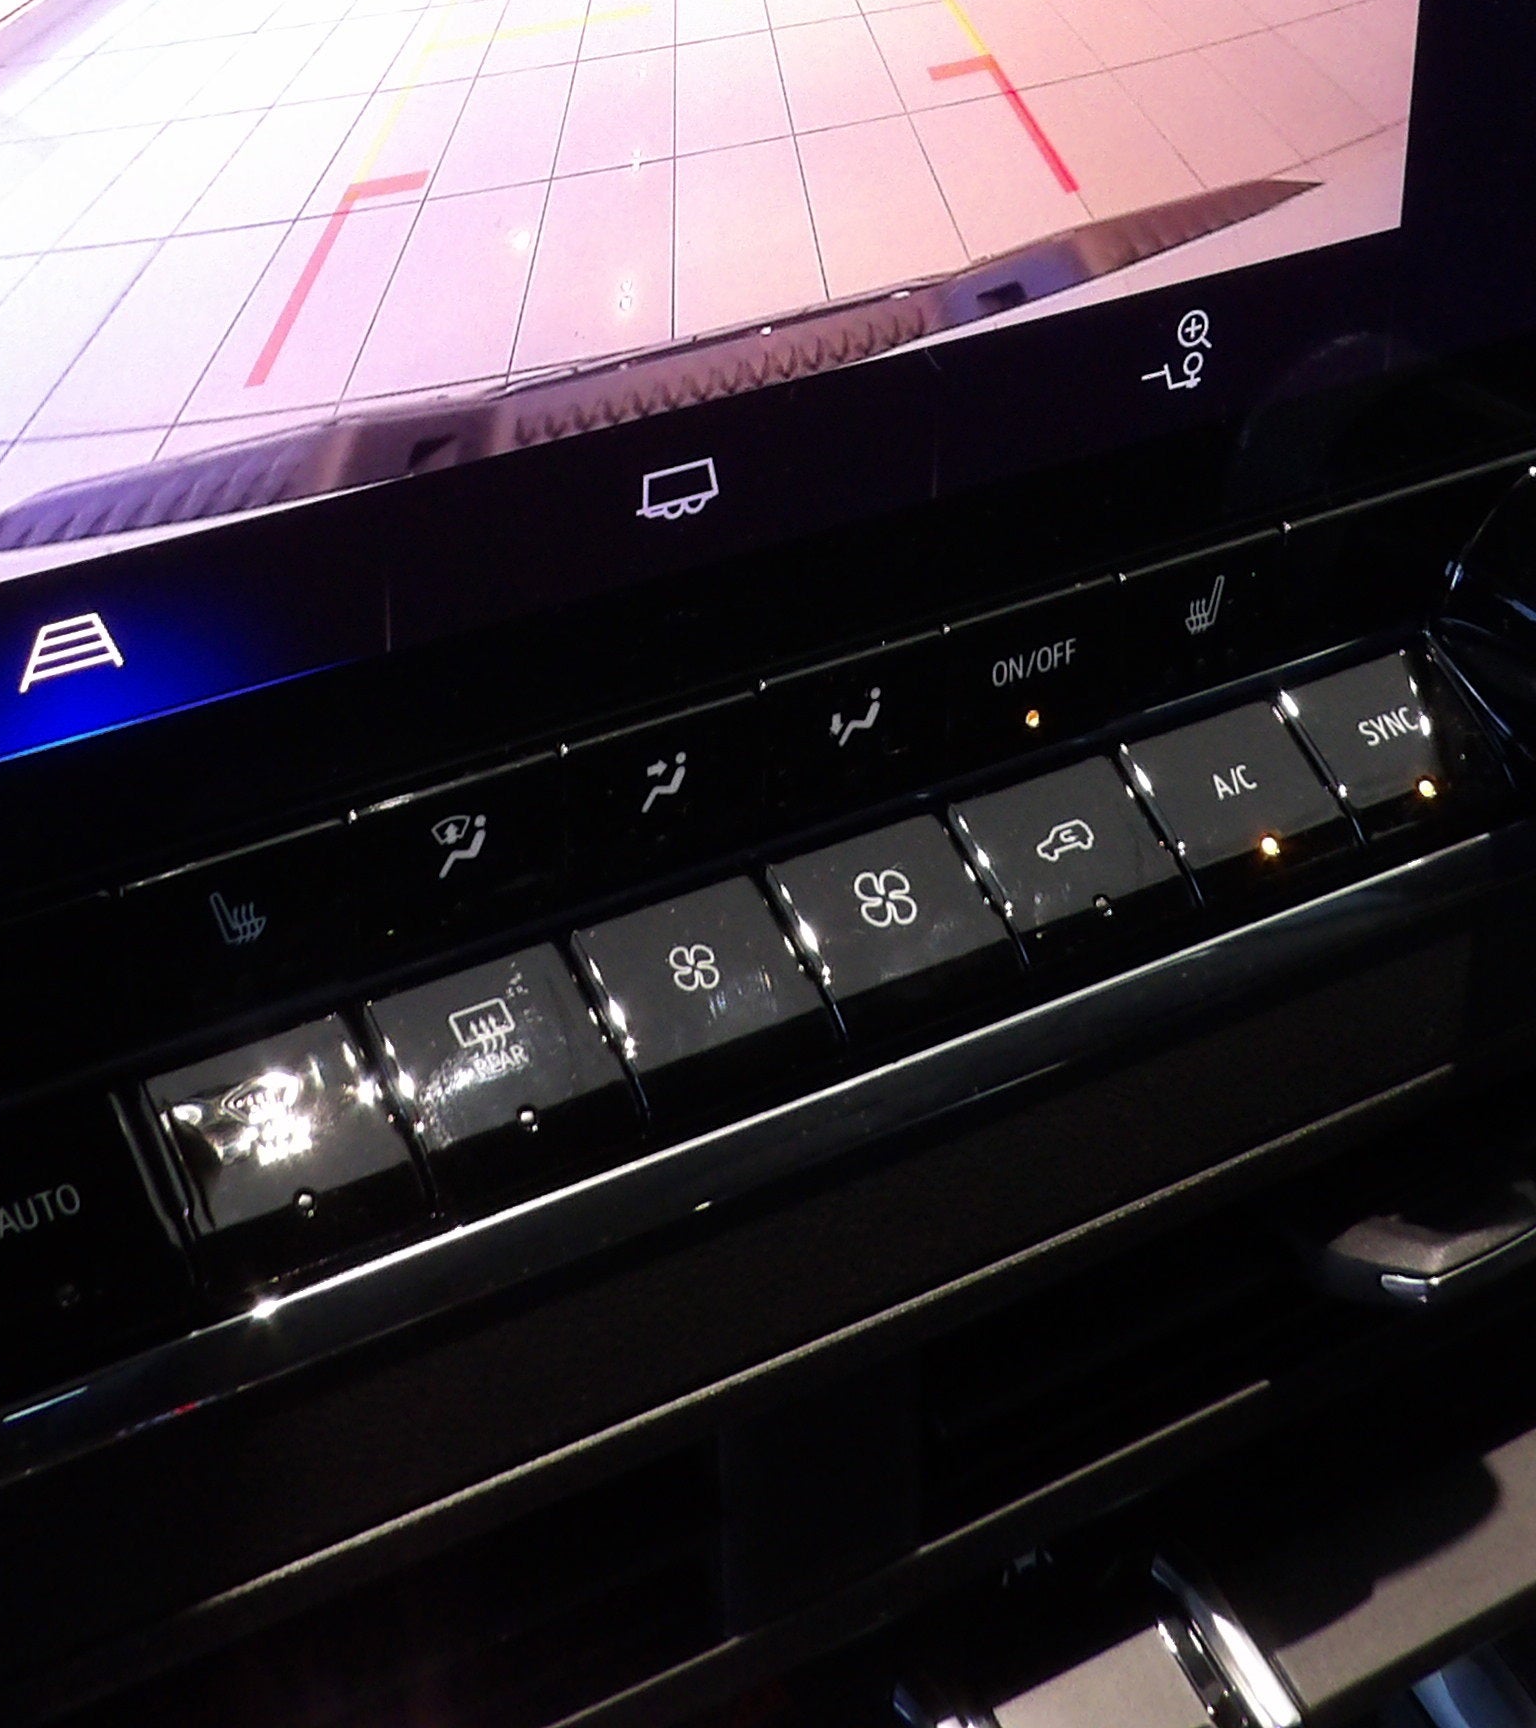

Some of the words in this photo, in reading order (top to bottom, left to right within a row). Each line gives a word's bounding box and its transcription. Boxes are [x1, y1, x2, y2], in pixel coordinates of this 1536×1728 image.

[991, 637, 1078, 688] ON/OFF
[1357, 705, 1421, 747] SYNC
[1212, 764, 1258, 801] A/C
[473, 1043, 530, 1079] REAR
